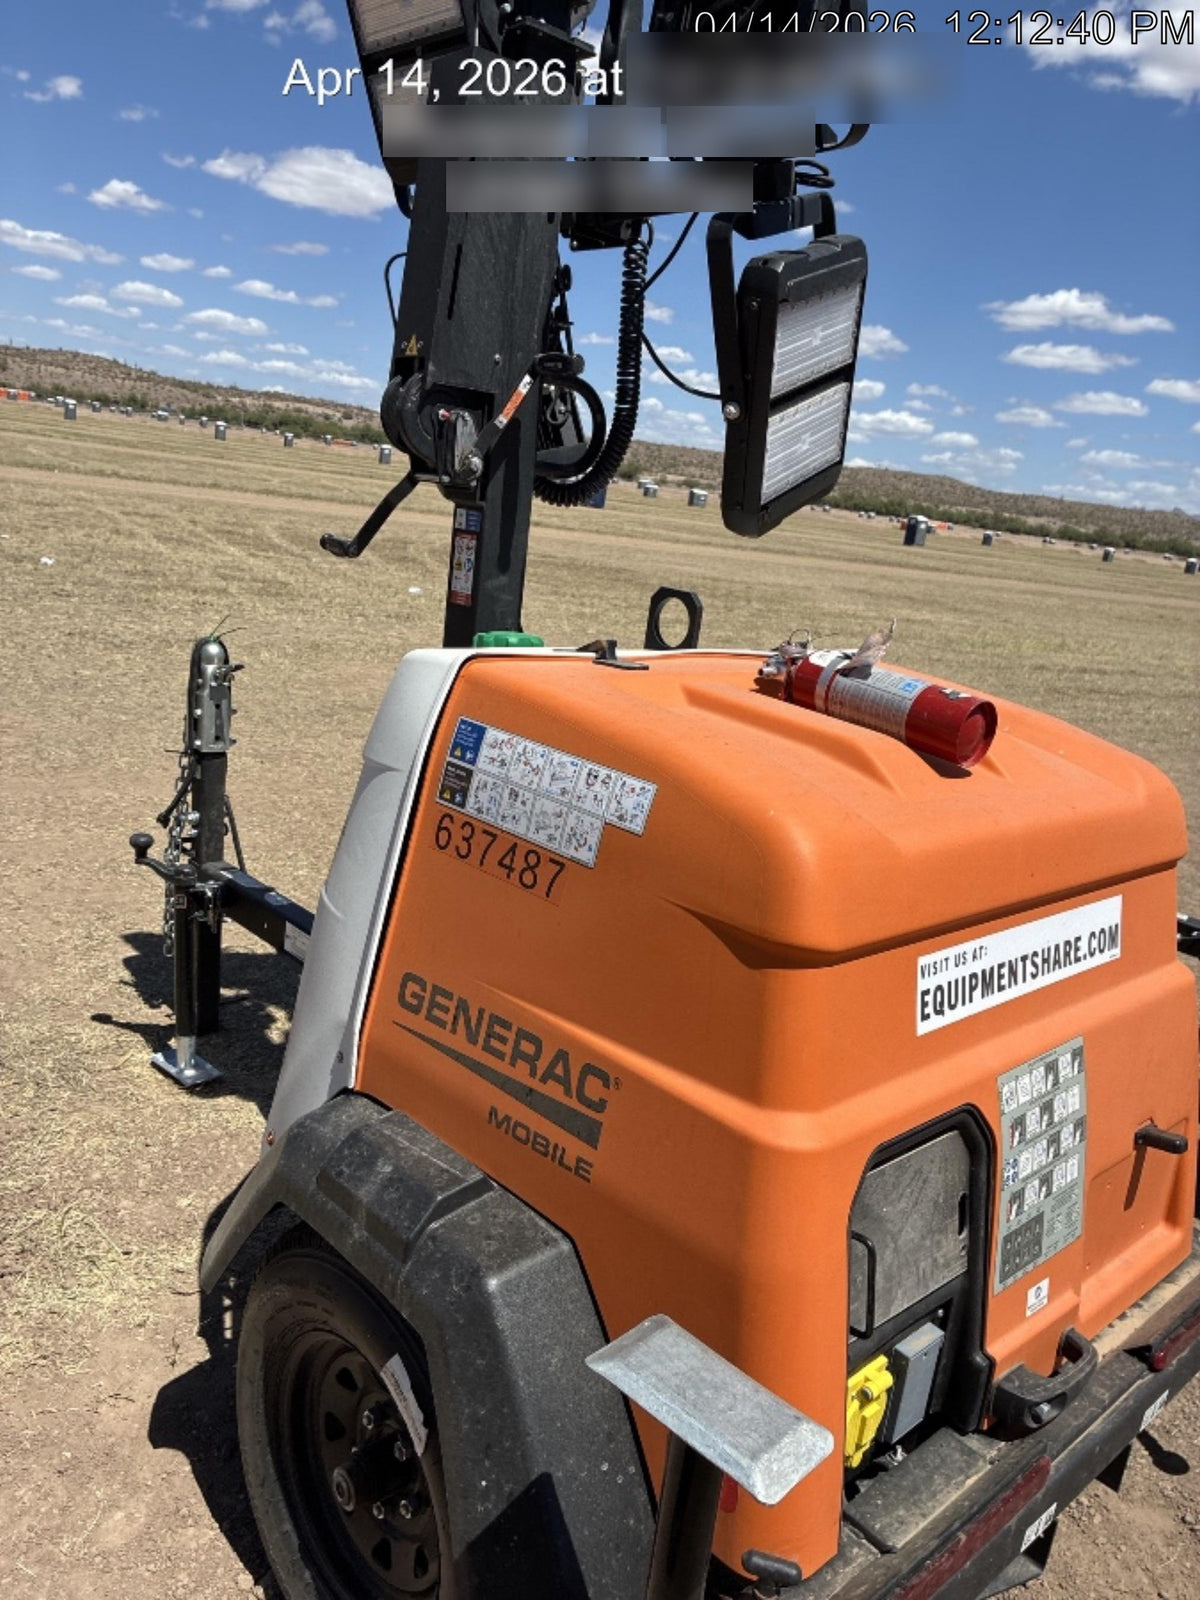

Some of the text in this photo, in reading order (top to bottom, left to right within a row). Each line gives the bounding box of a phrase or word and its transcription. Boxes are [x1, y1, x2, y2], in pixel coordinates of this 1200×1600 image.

[434, 812, 567, 899] 637487
[919, 945, 989, 980] VISIT US AT:
[920, 922, 1120, 1022] EQUIPMENTSHARE.COM
[487, 1105, 595, 1184] MOBILE
